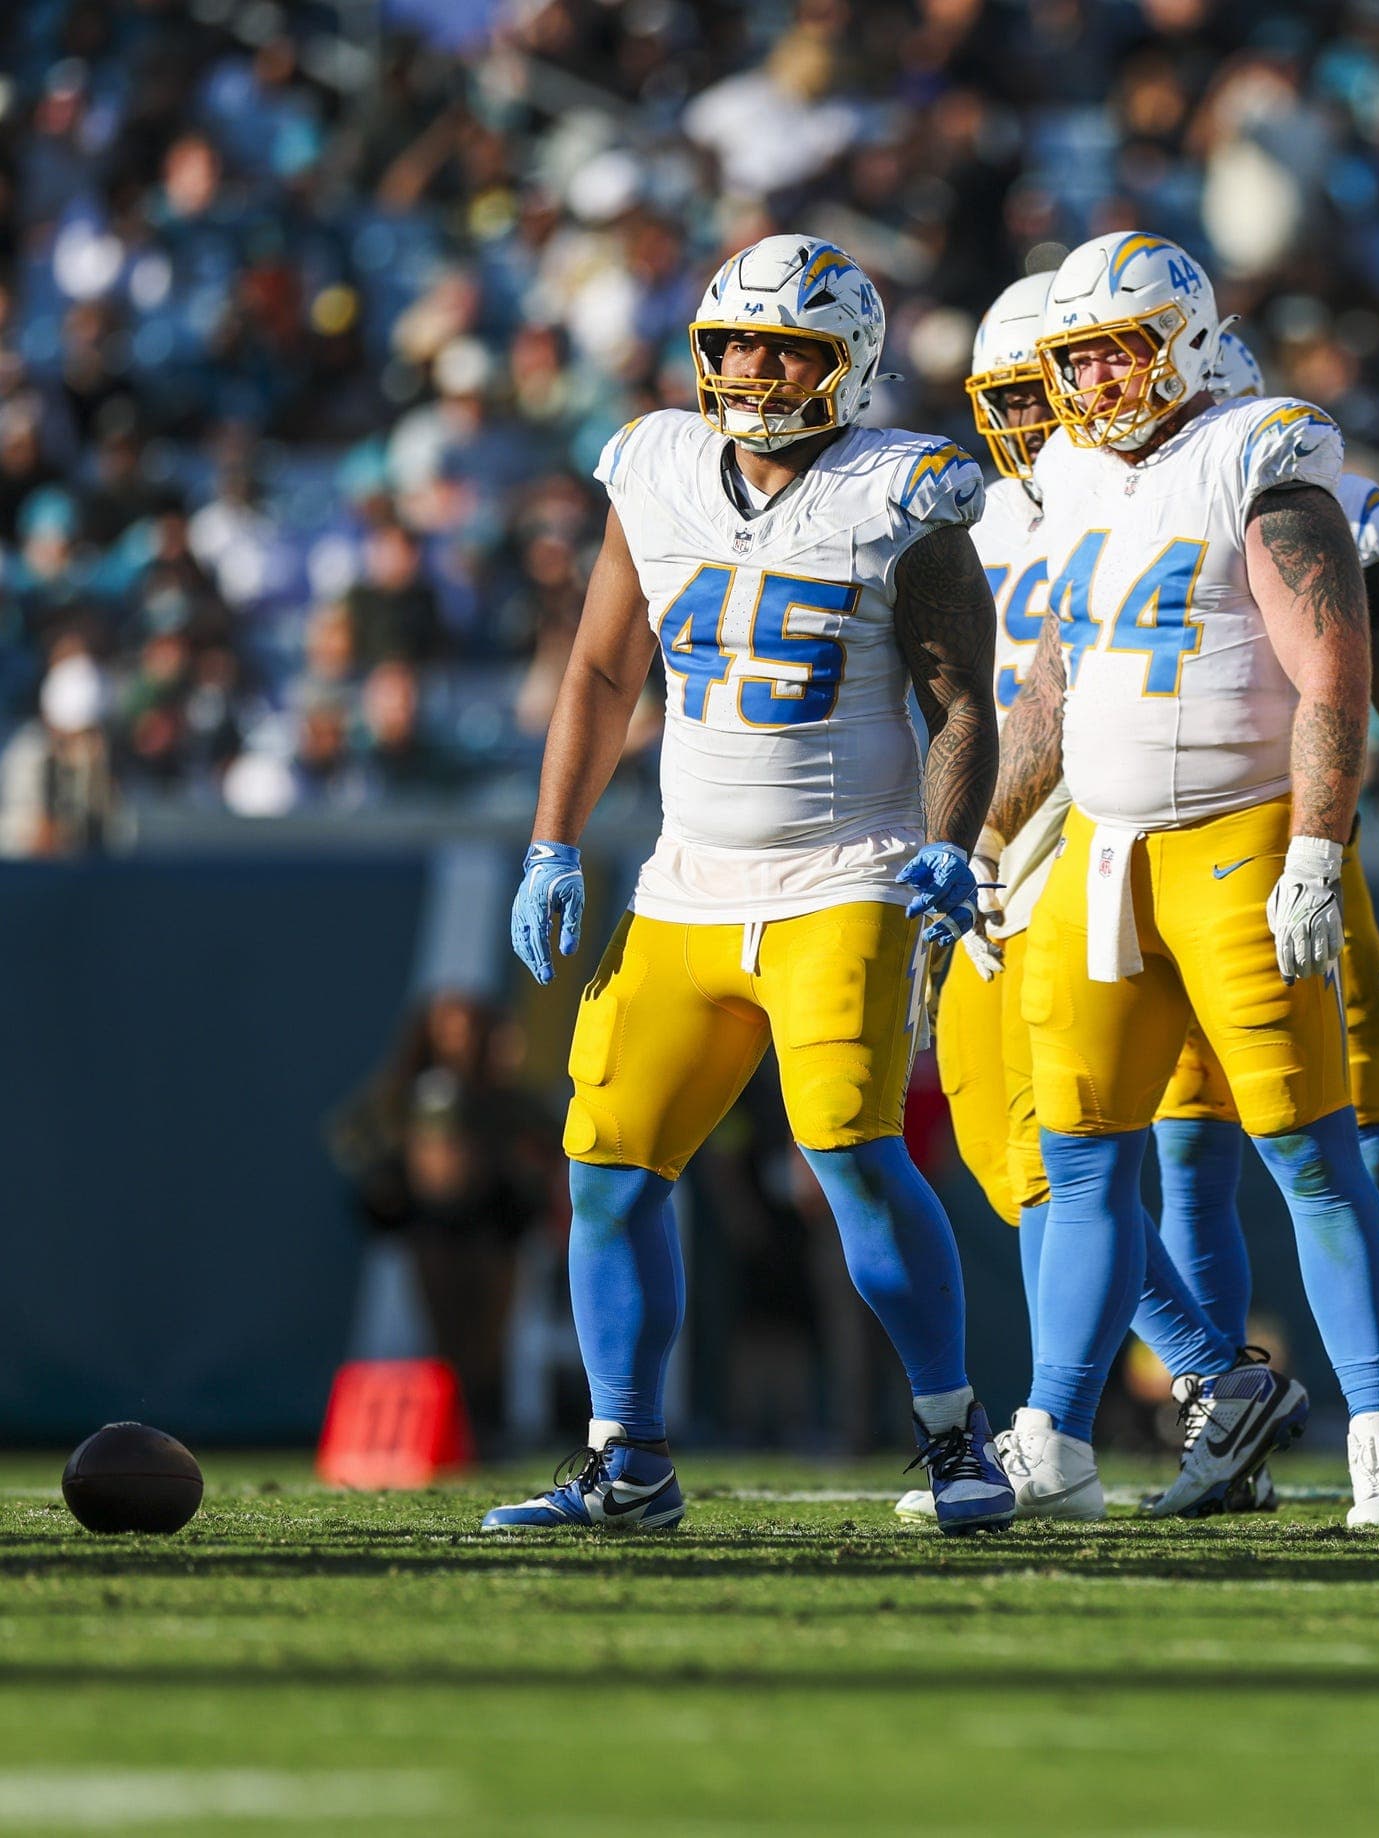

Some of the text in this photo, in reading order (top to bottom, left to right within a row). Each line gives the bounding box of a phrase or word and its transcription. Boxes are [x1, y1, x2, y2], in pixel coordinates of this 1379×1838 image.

[1167, 255, 1202, 295] 44
[656, 561, 863, 729] 45
[1049, 528, 1210, 698] 44
